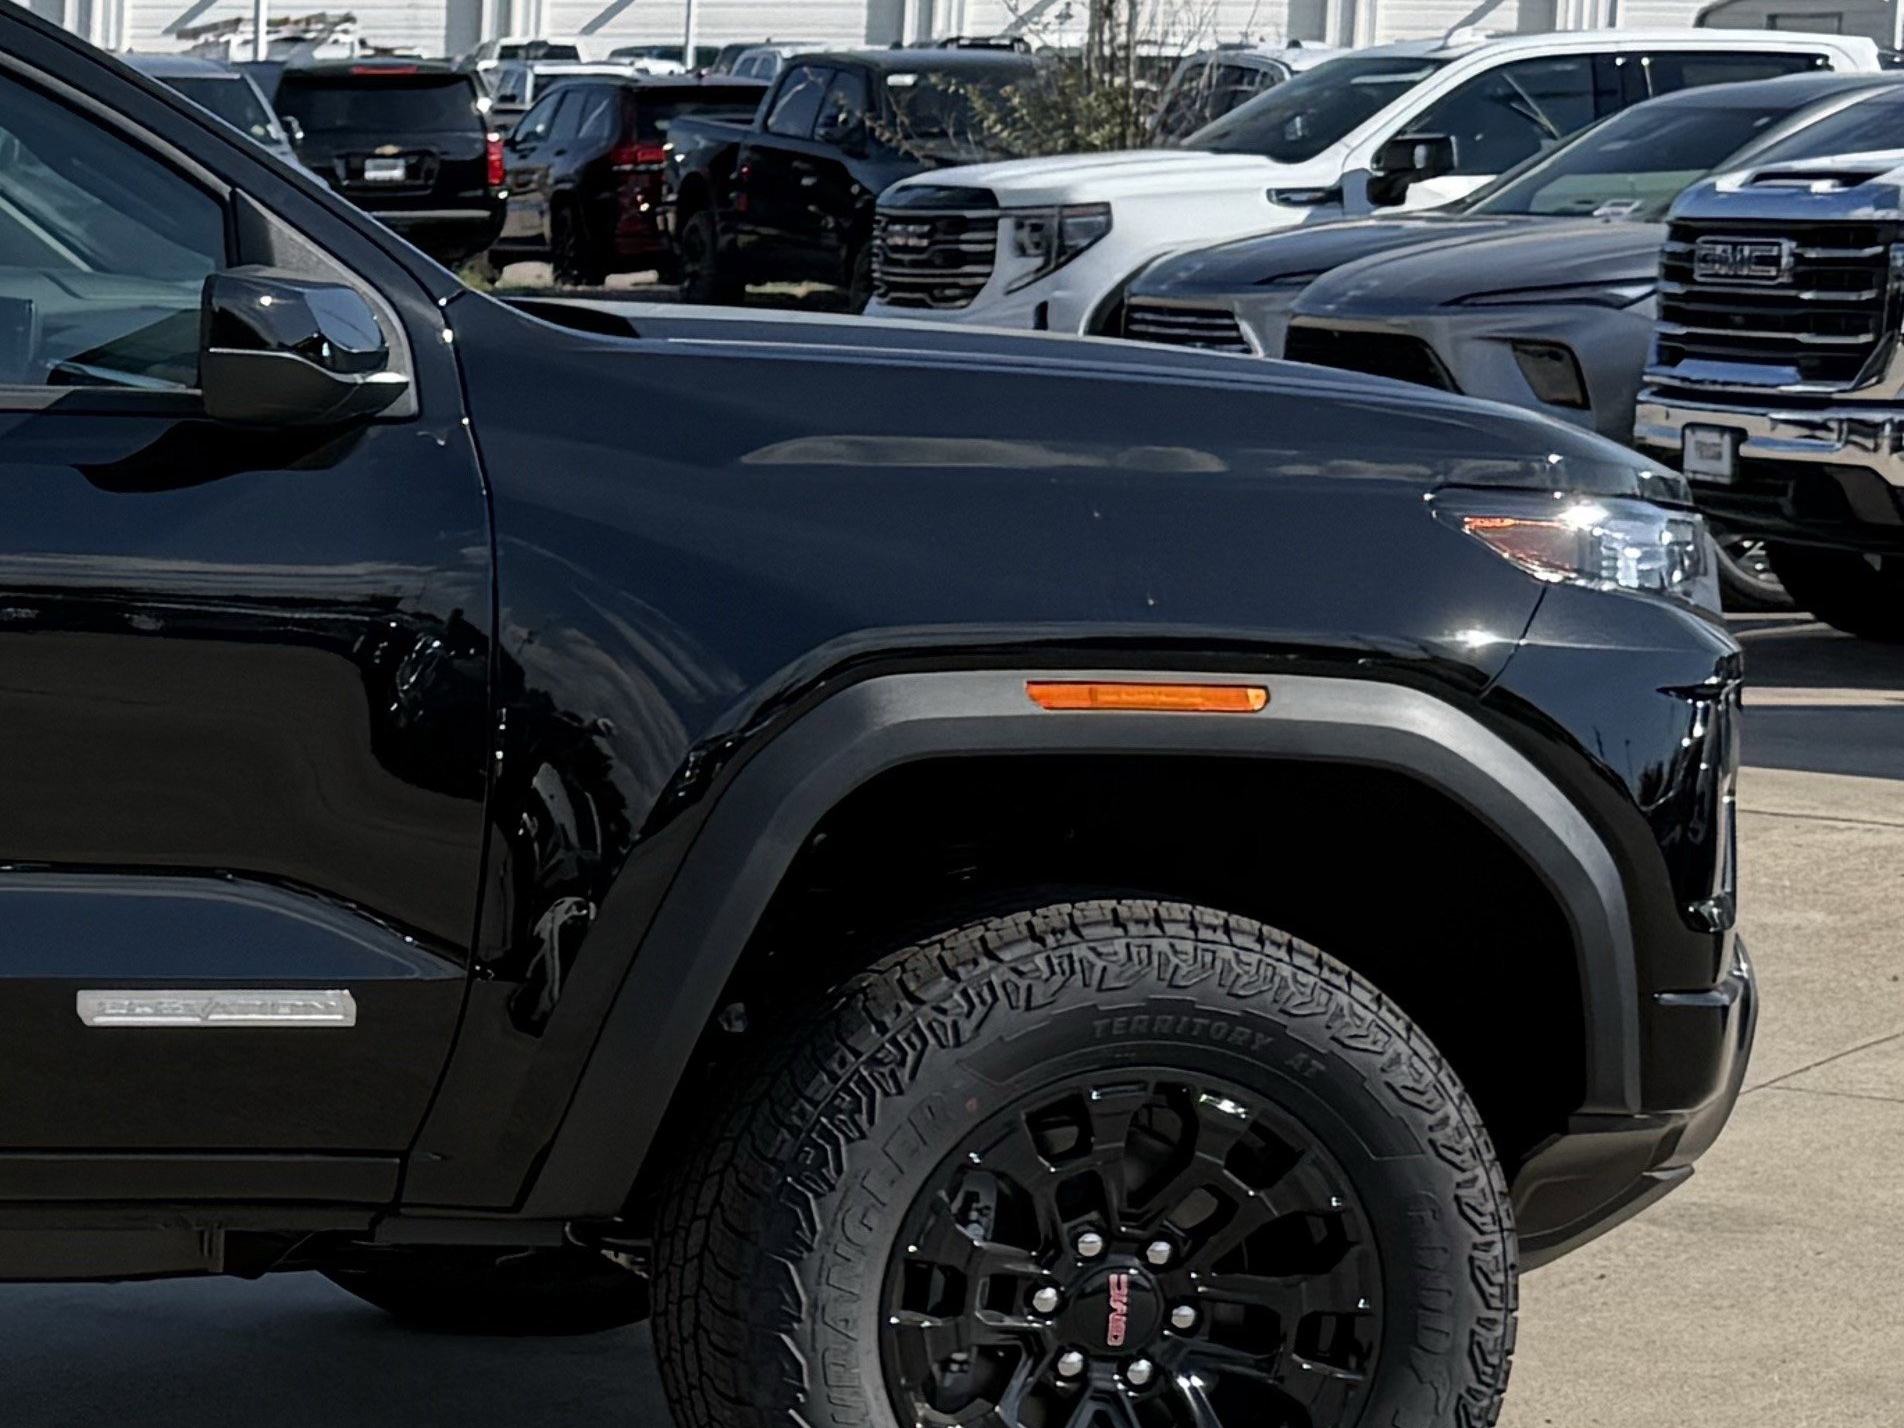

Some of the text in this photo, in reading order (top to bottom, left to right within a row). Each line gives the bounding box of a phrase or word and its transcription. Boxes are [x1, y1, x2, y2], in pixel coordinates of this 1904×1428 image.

[1695, 244, 1780, 276] GMC
[1091, 1014, 1328, 1078] TERRITORY AT
[1107, 1273, 1128, 1346] GMC
